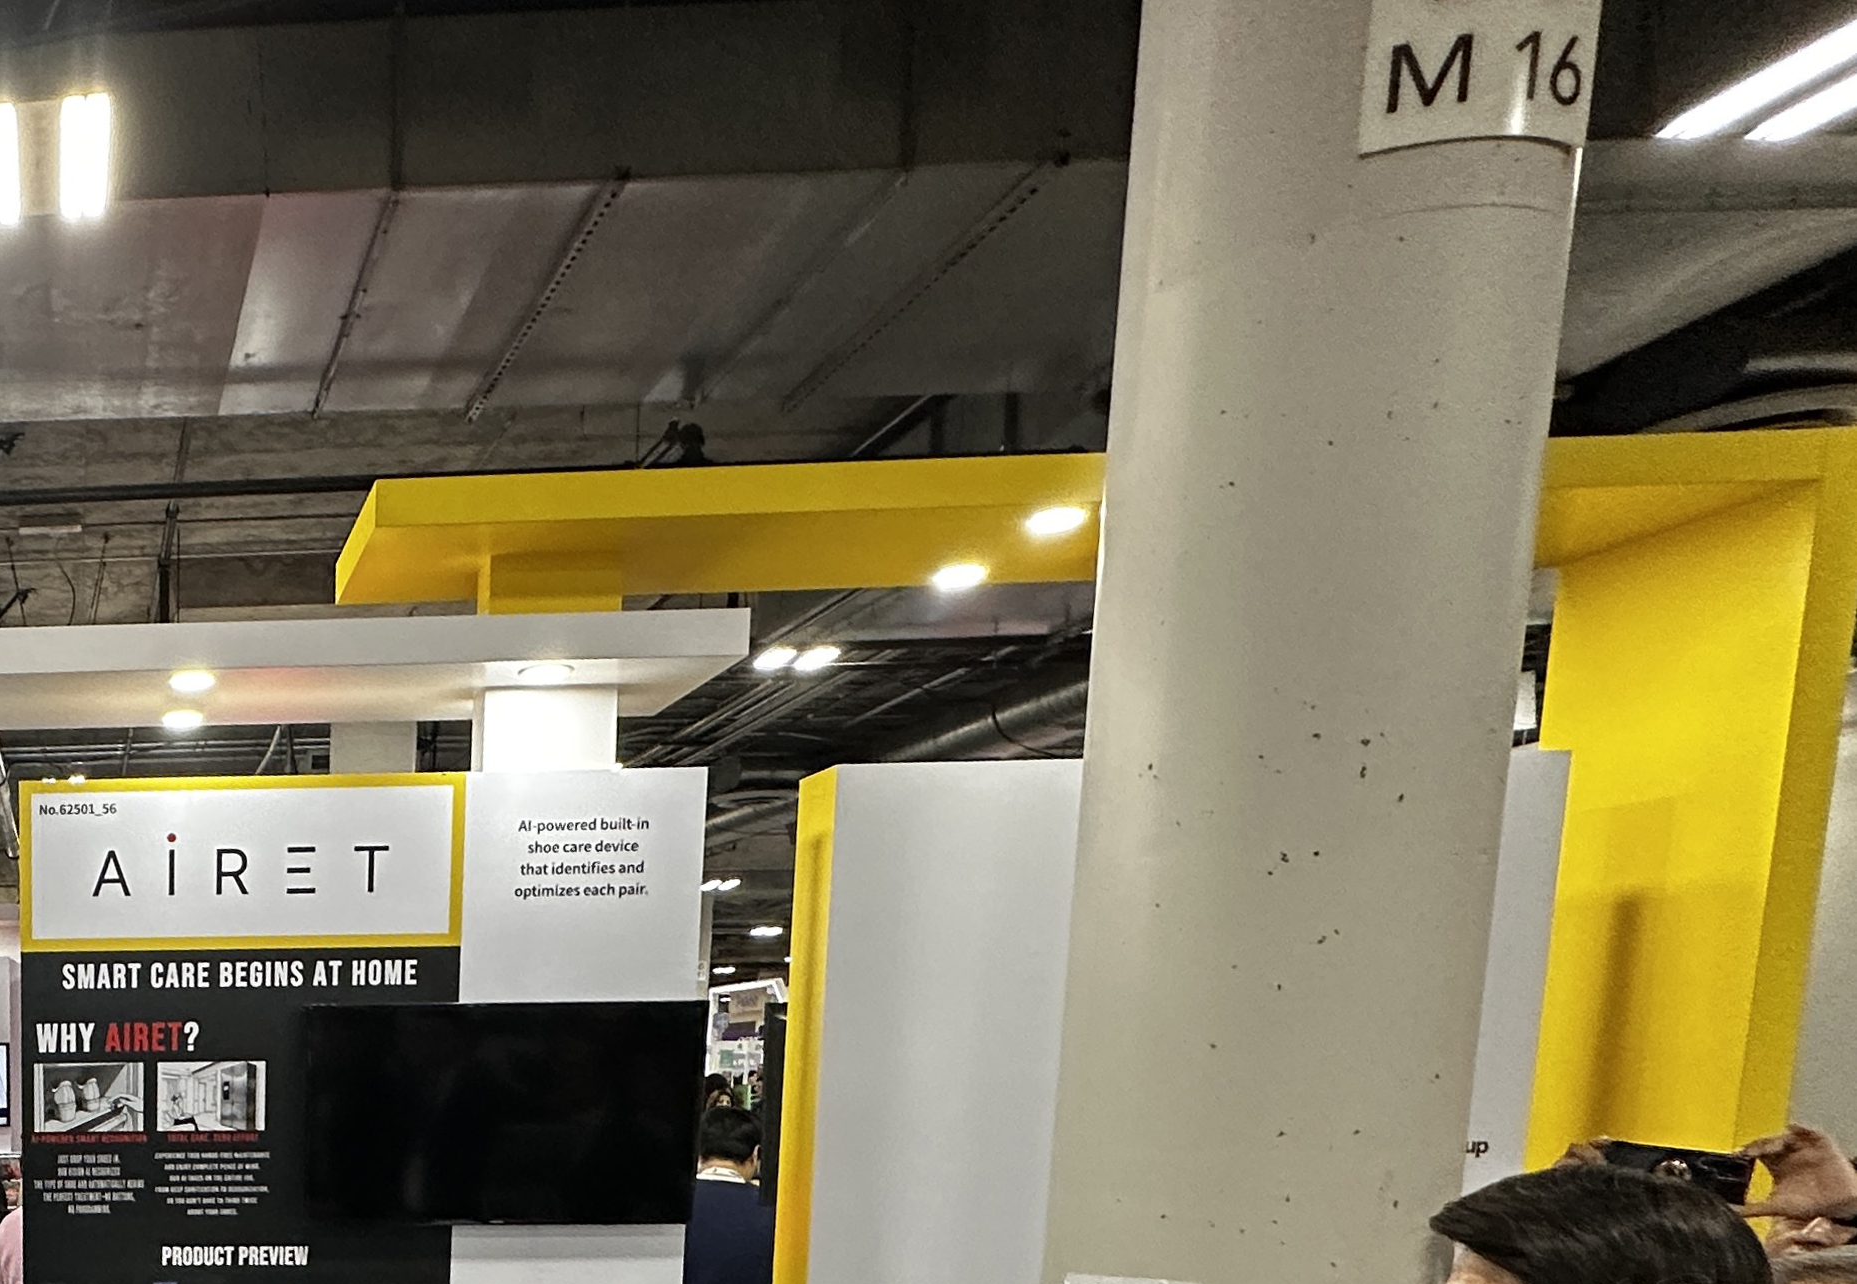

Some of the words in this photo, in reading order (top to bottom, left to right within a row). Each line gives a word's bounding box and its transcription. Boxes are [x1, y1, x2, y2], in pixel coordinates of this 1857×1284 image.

[1386, 33, 1474, 114] M
[1515, 29, 1581, 106] 16
[38, 803, 118, 817] No.62501_56
[518, 818, 597, 834] AI-powered
[600, 817, 650, 830] built-in
[527, 841, 560, 853] shoe
[562, 843, 592, 853] care
[594, 840, 639, 853] device
[520, 863, 548, 876] that
[551, 861, 615, 875] identifies
[618, 860, 645, 874] and
[514, 885, 580, 900] optimizes
[583, 884, 615, 896] each
[618, 882, 648, 898] pair.
[61, 963, 141, 991] SMART
[150, 962, 210, 988] CARE
[218, 961, 304, 988] BEGINS
[312, 960, 342, 986] AT
[351, 959, 418, 986] HOME
[36, 1022, 95, 1053] WHY
[104, 1021, 200, 1053] AIRET?
[161, 1246, 235, 1267] PRODUCT
[238, 1246, 309, 1266] PREVIEW
